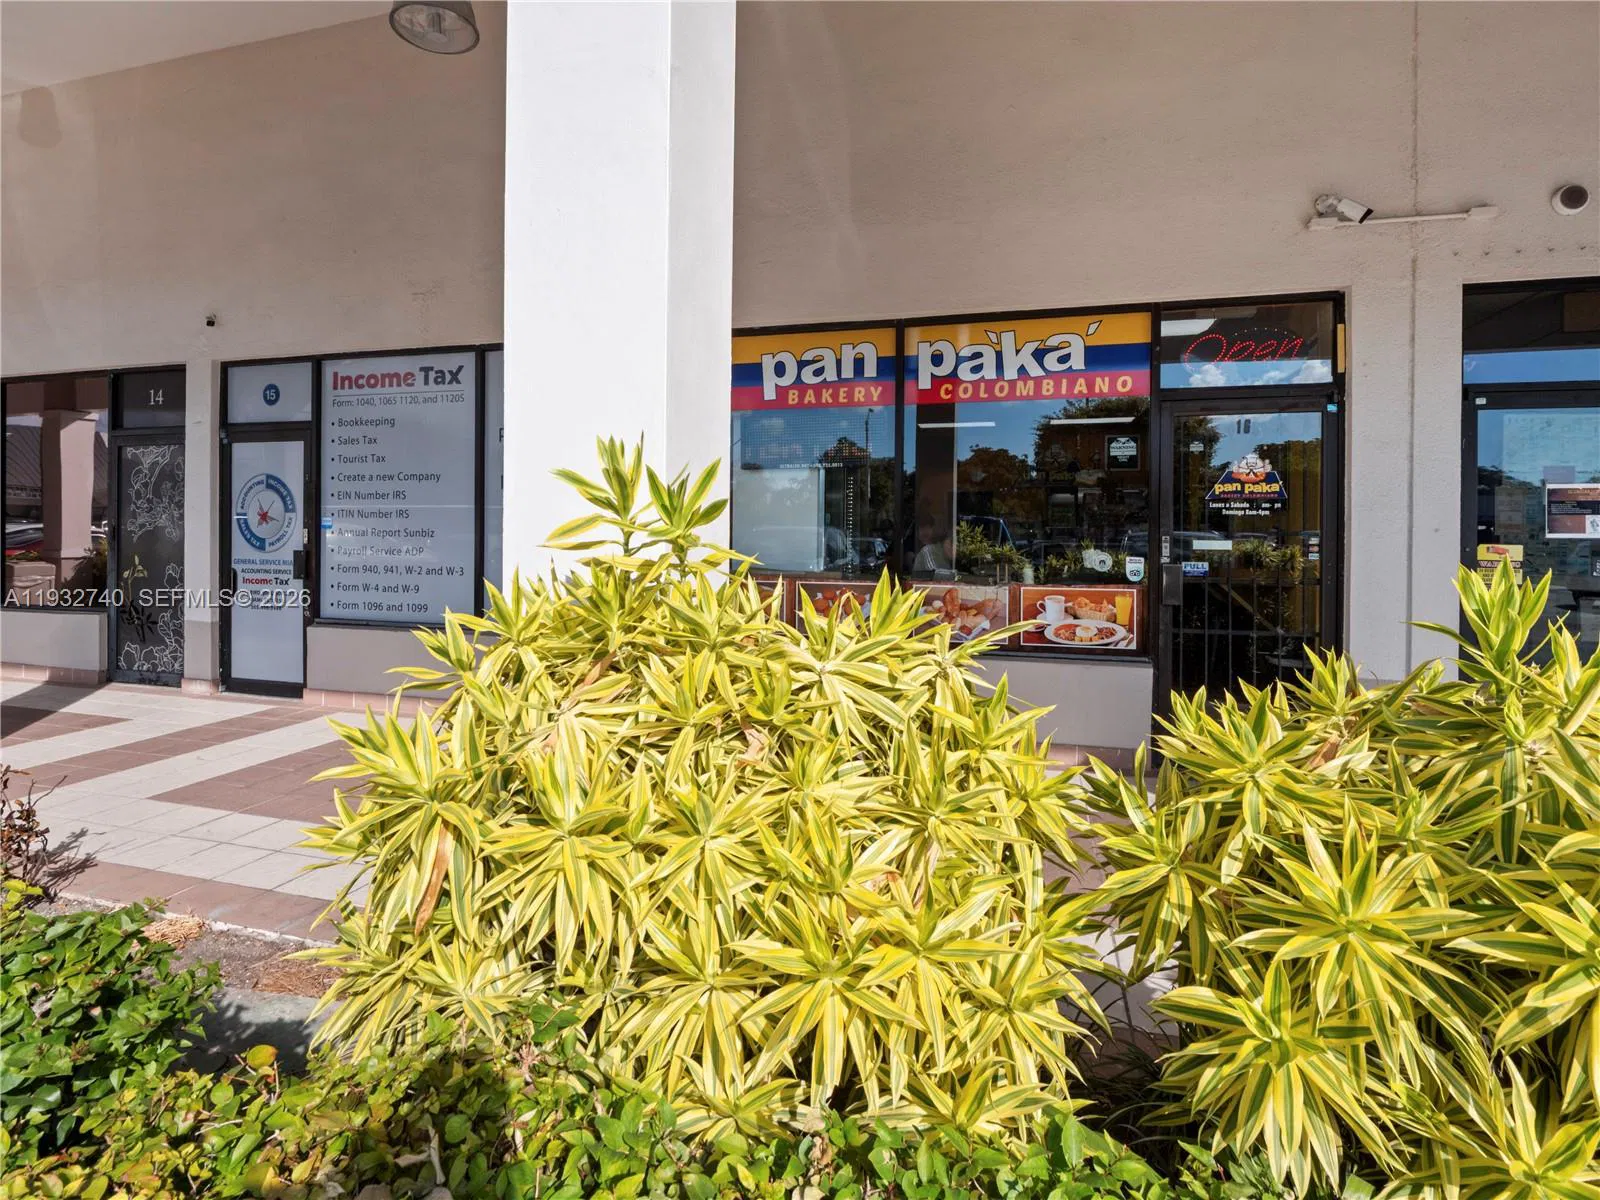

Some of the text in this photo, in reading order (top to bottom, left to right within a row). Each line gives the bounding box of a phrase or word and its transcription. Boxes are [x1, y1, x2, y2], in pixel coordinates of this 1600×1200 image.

[761, 342, 878, 401] pan
[332, 365, 465, 391] Income Tax
[264, 389, 276, 401] 15
[787, 375, 1134, 406] BAKERY COLOMBIANO
[149, 389, 165, 405] 14
[422, 394, 438, 404] and
[337, 417, 396, 428] Bookkeeping
[337, 435, 378, 446] Sales Tax
[337, 453, 386, 464] Tourist Tax
[337, 472, 366, 482] Create
[376, 474, 396, 482] new
[397, 471, 441, 484] Company
[337, 489, 407, 500] EIN Number IRS
[1214, 482, 1242, 495] pan
[337, 509, 410, 519] ITIN Number IRS
[337, 527, 435, 539] Annual Report Sunbiz
[337, 545, 425, 558] Payroll Service ADP
[259, 558, 281, 566] SERVICE
[337, 564, 465, 577] Form 940, 941, W-2 and W-3
[242, 576, 290, 586] Income Tax
[337, 582, 420, 594] Form W-4 and W-9
[337, 600, 429, 613] Form 1096 and 1099
